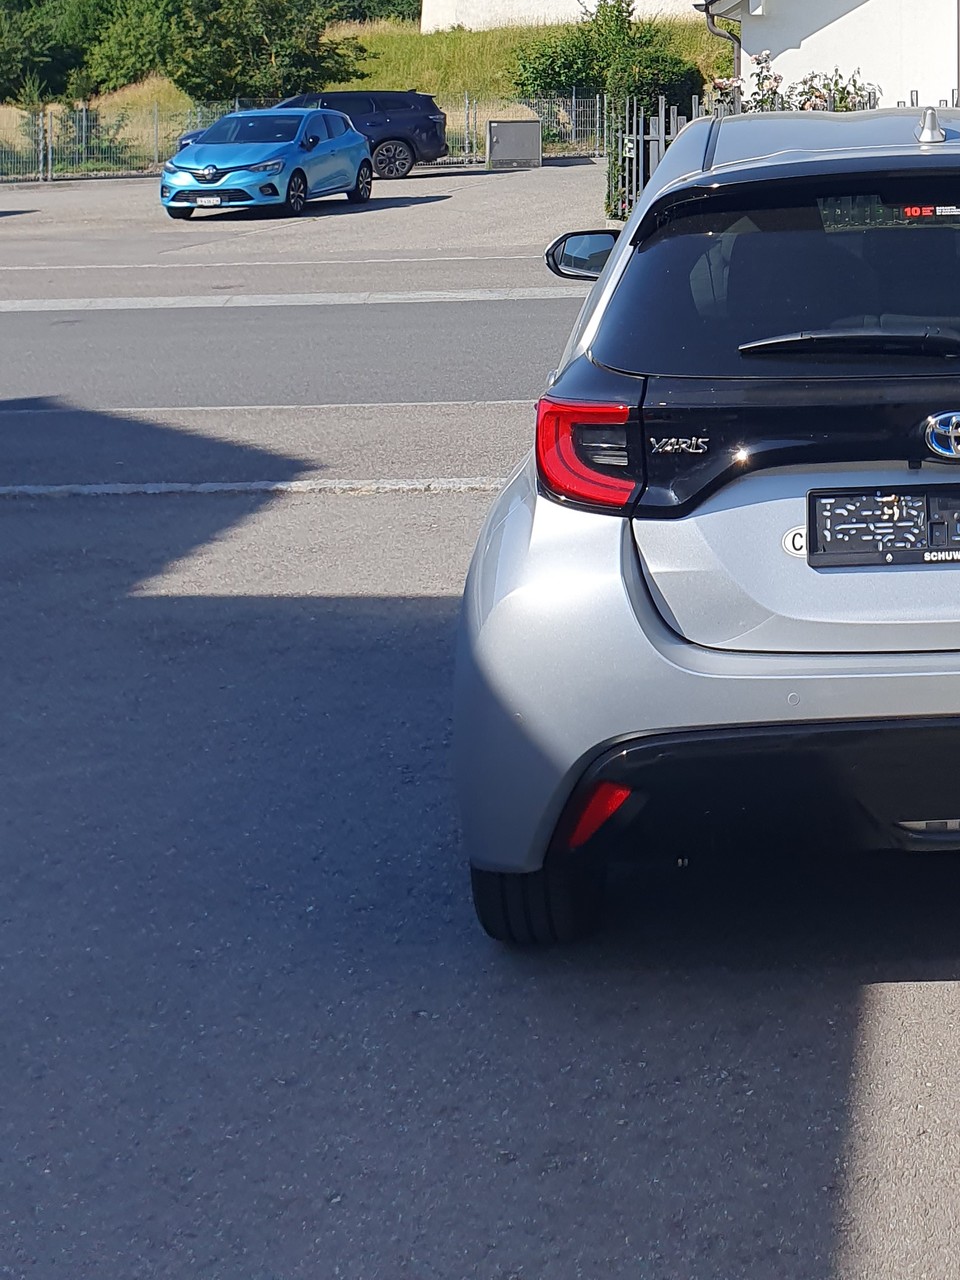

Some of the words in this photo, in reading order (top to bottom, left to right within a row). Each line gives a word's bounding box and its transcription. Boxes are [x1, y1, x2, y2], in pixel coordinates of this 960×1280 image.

[904, 206, 921, 216] 10
[650, 437, 709, 453] YARIS
[791, 532, 808, 552] C
